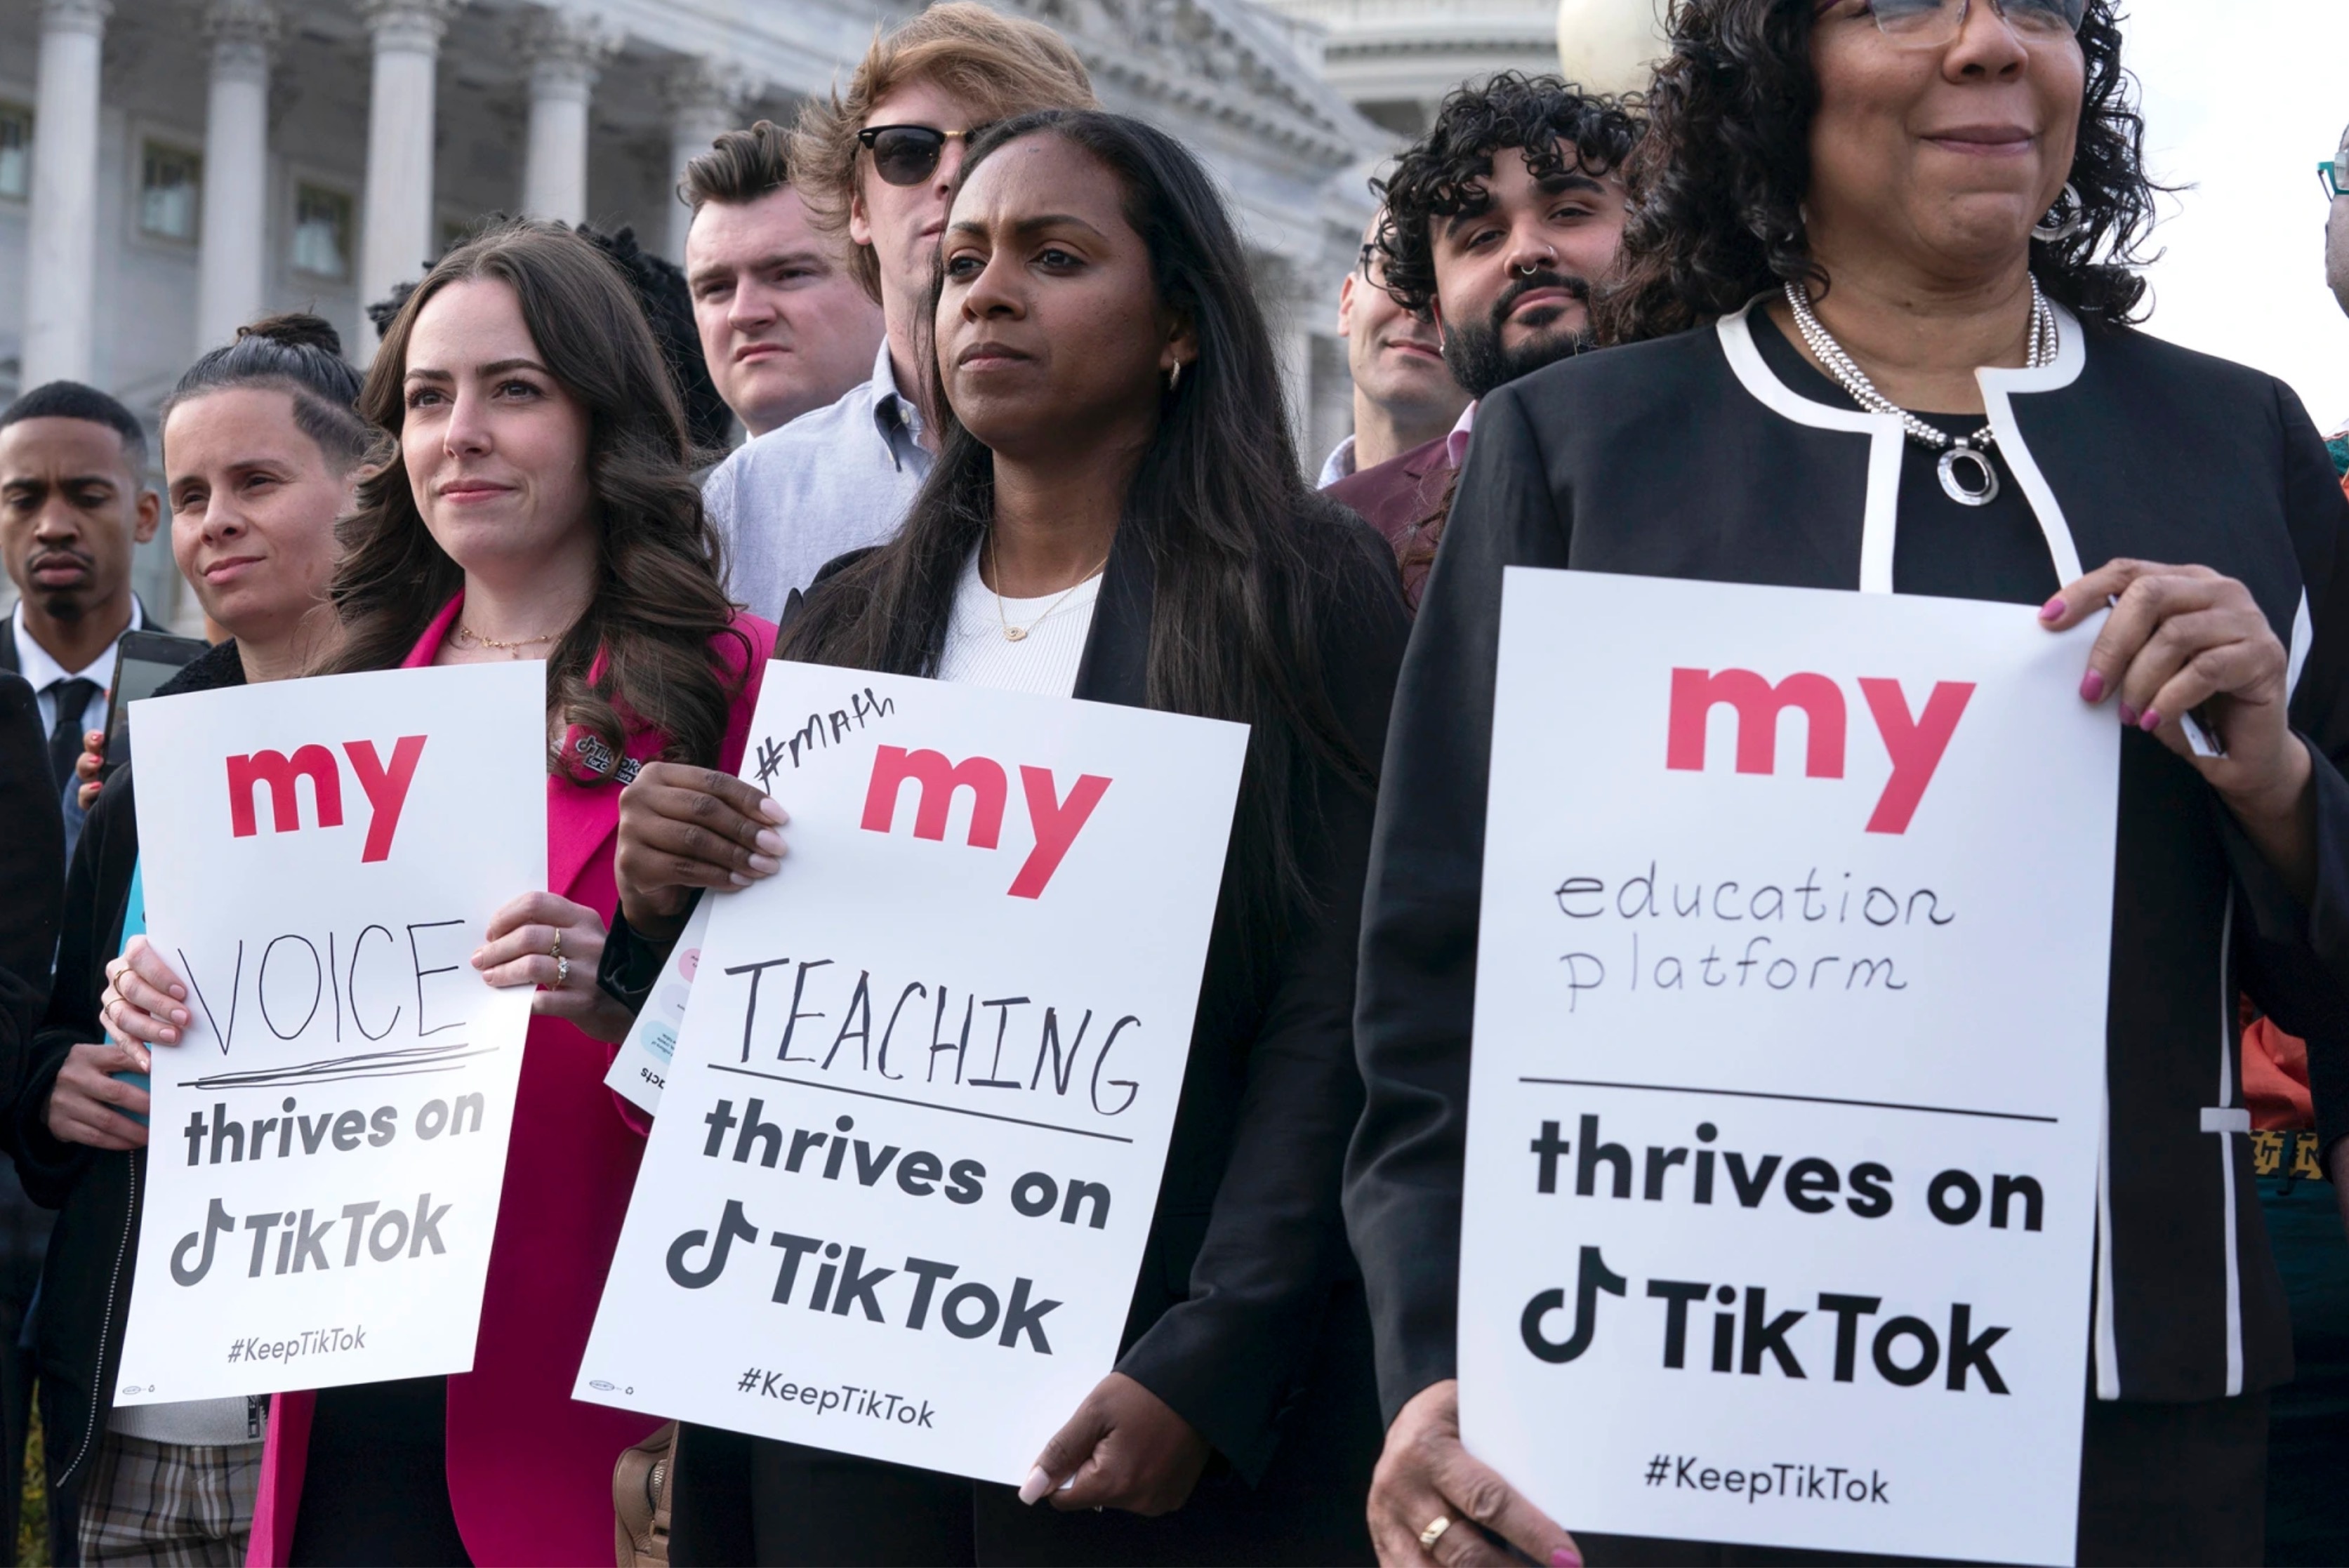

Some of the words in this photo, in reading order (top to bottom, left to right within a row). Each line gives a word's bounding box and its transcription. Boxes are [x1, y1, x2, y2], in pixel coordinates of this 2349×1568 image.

[226, 735, 428, 863] my
[595, 744, 640, 773] Tikok
[1666, 667, 1977, 835] my
[860, 745, 1113, 900] my
[1554, 861, 1955, 926] education
[177, 919, 466, 1056] VOICE
[1560, 932, 1907, 1013] platform
[724, 957, 1142, 1116] TEACHING
[184, 1096, 397, 1167] thrives
[416, 1093, 484, 1140] on
[703, 1097, 986, 1204] thrives
[1011, 1171, 1111, 1230] on
[1530, 1113, 1894, 1220] thrives
[1926, 1168, 2044, 1233] on
[244, 1193, 453, 1278] TikTok
[770, 1231, 1064, 1355] TikTok
[228, 1324, 366, 1364] #KeepTikTok
[1646, 1278, 2012, 1396] TikTok
[738, 1367, 935, 1428] #KeepTikTok
[1644, 1454, 1889, 1504] #KeepTikTok
